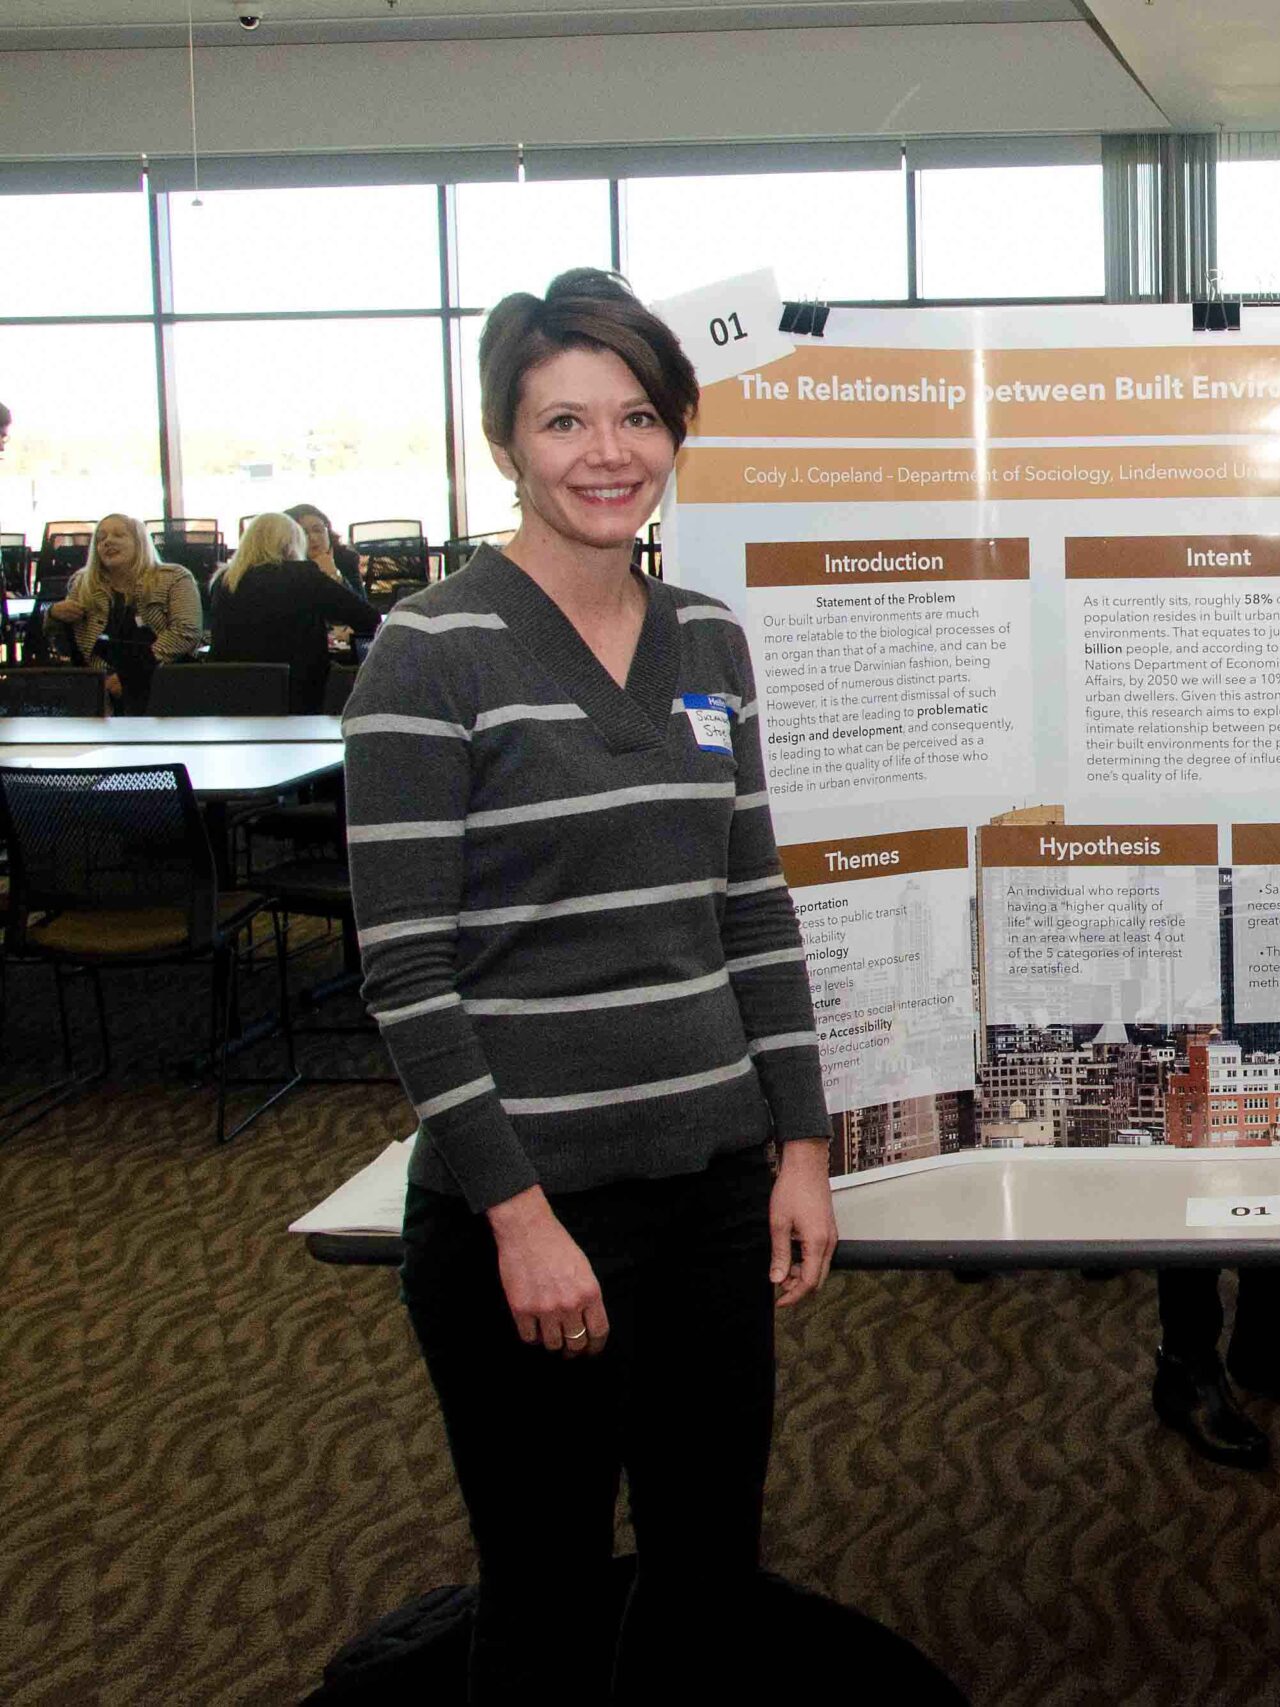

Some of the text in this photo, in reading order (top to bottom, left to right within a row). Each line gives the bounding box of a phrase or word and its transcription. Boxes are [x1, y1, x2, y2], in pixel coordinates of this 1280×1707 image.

[708, 311, 748, 347] 01
[738, 374, 789, 401] The
[798, 375, 966, 410] Relationship
[1115, 375, 1184, 402] Built
[744, 465, 786, 489] Cody
[790, 466, 803, 486] J.
[807, 464, 884, 489] Copeland
[1002, 464, 1021, 484] of
[1024, 462, 1114, 488] Sociology,
[1119, 460, 1228, 481] Lindenwood
[824, 551, 944, 574] Introduction
[1186, 547, 1252, 567] Intent
[816, 592, 956, 609] Statement of the Problem
[1244, 593, 1273, 605] 58%
[1084, 643, 1123, 655] billion
[917, 703, 988, 718] problematic
[768, 730, 806, 745] design
[808, 729, 830, 742] and
[1039, 836, 1161, 861] Hypothesis
[825, 847, 900, 872] Themes
[1007, 884, 1160, 899] An individual who reports
[795, 897, 849, 916] sportation
[1007, 900, 1047, 915] having
[1049, 903, 1058, 912] a
[1108, 899, 1148, 915] quality
[1150, 899, 1164, 912] of
[841, 905, 907, 927] public transit
[1034, 915, 1053, 927] will
[1056, 915, 1146, 931] geographically
[1149, 915, 1186, 927] reside
[1008, 931, 1186, 943] in an area where at least 4 out
[805, 947, 849, 961] miology
[868, 951, 921, 970] exposures
[1008, 946, 1183, 962] of the 5 categories of interest
[1009, 962, 1083, 975] are satisfied.
[867, 993, 955, 1018] social interaction
[829, 1019, 893, 1040] Accessibility
[1230, 1206, 1272, 1217] 01
